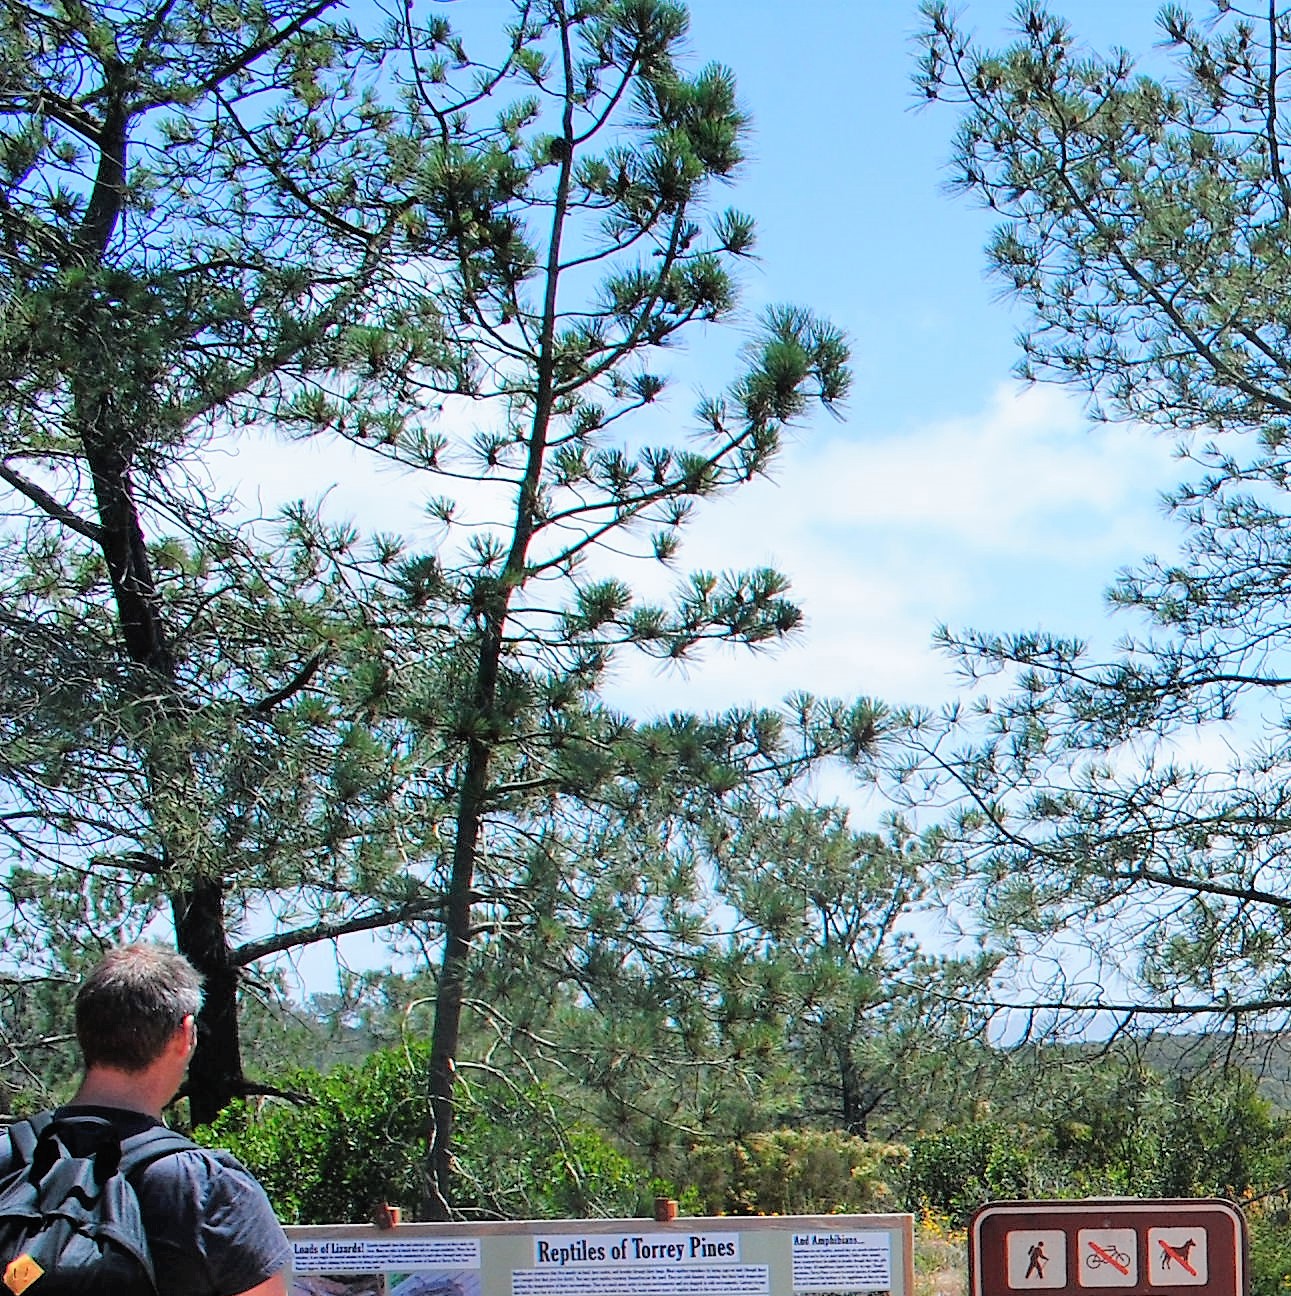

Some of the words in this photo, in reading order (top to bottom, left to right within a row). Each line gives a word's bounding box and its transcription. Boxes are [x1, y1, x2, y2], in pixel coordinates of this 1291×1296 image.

[793, 1235, 809, 1245] And
[294, 1243, 318, 1254] Loads
[321, 1243, 330, 1254] of
[331, 1242, 364, 1254] Lizards!
[537, 1240, 605, 1266] Reptiles
[611, 1238, 628, 1259] of
[631, 1237, 685, 1262] Torrey
[689, 1236, 735, 1257] Pines
